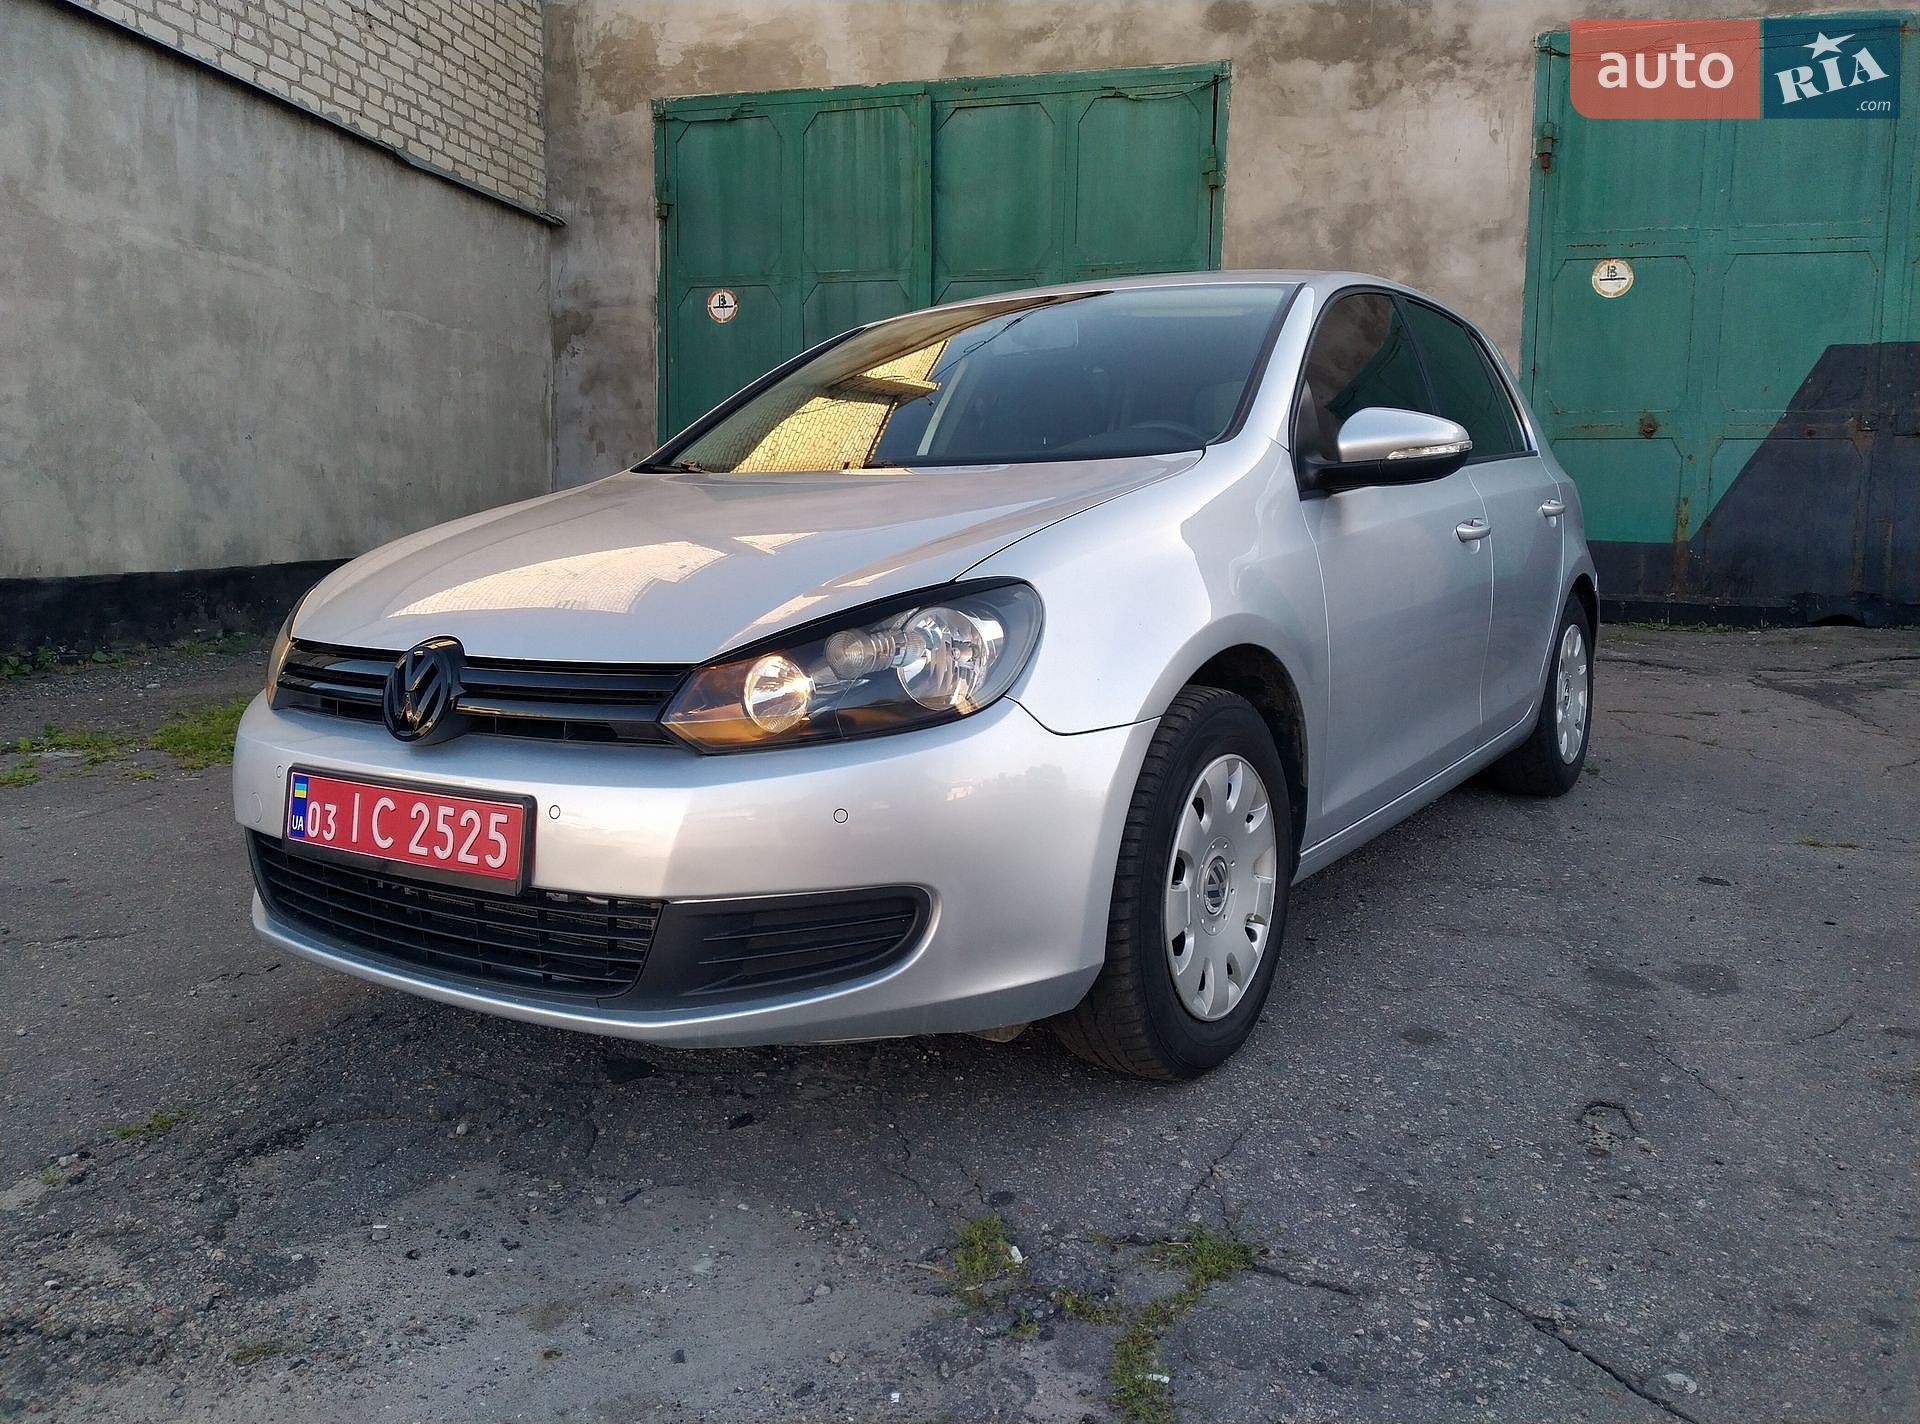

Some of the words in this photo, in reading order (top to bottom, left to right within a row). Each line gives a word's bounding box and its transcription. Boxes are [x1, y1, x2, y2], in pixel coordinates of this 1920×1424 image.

[292, 814, 304, 831] UA
[306, 801, 337, 841] 03
[408, 802, 508, 869] 2525
